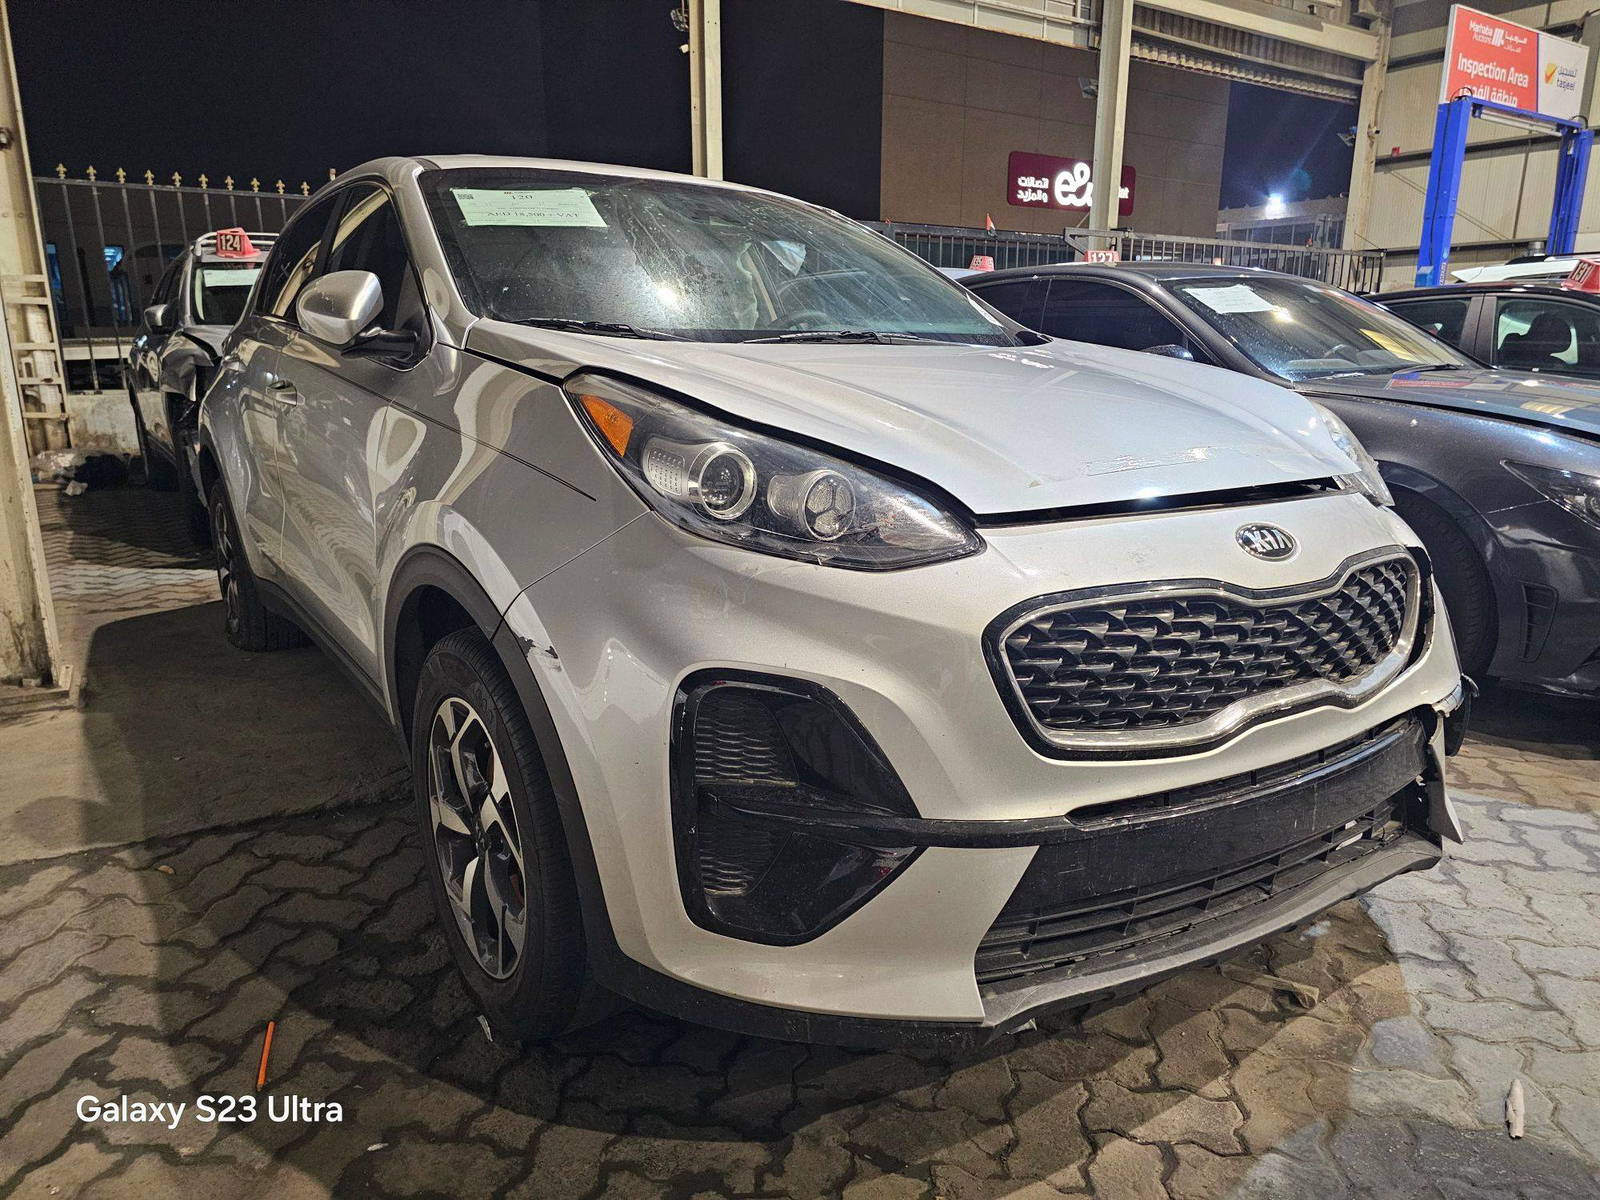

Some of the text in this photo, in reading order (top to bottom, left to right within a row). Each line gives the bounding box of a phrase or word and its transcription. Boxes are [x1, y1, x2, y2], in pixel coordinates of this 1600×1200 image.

[1457, 53, 1529, 88] Inspection Area
[1017, 176, 1049, 188] اتصالات
[220, 234, 240, 251] 124
[1242, 528, 1294, 553] KIA
